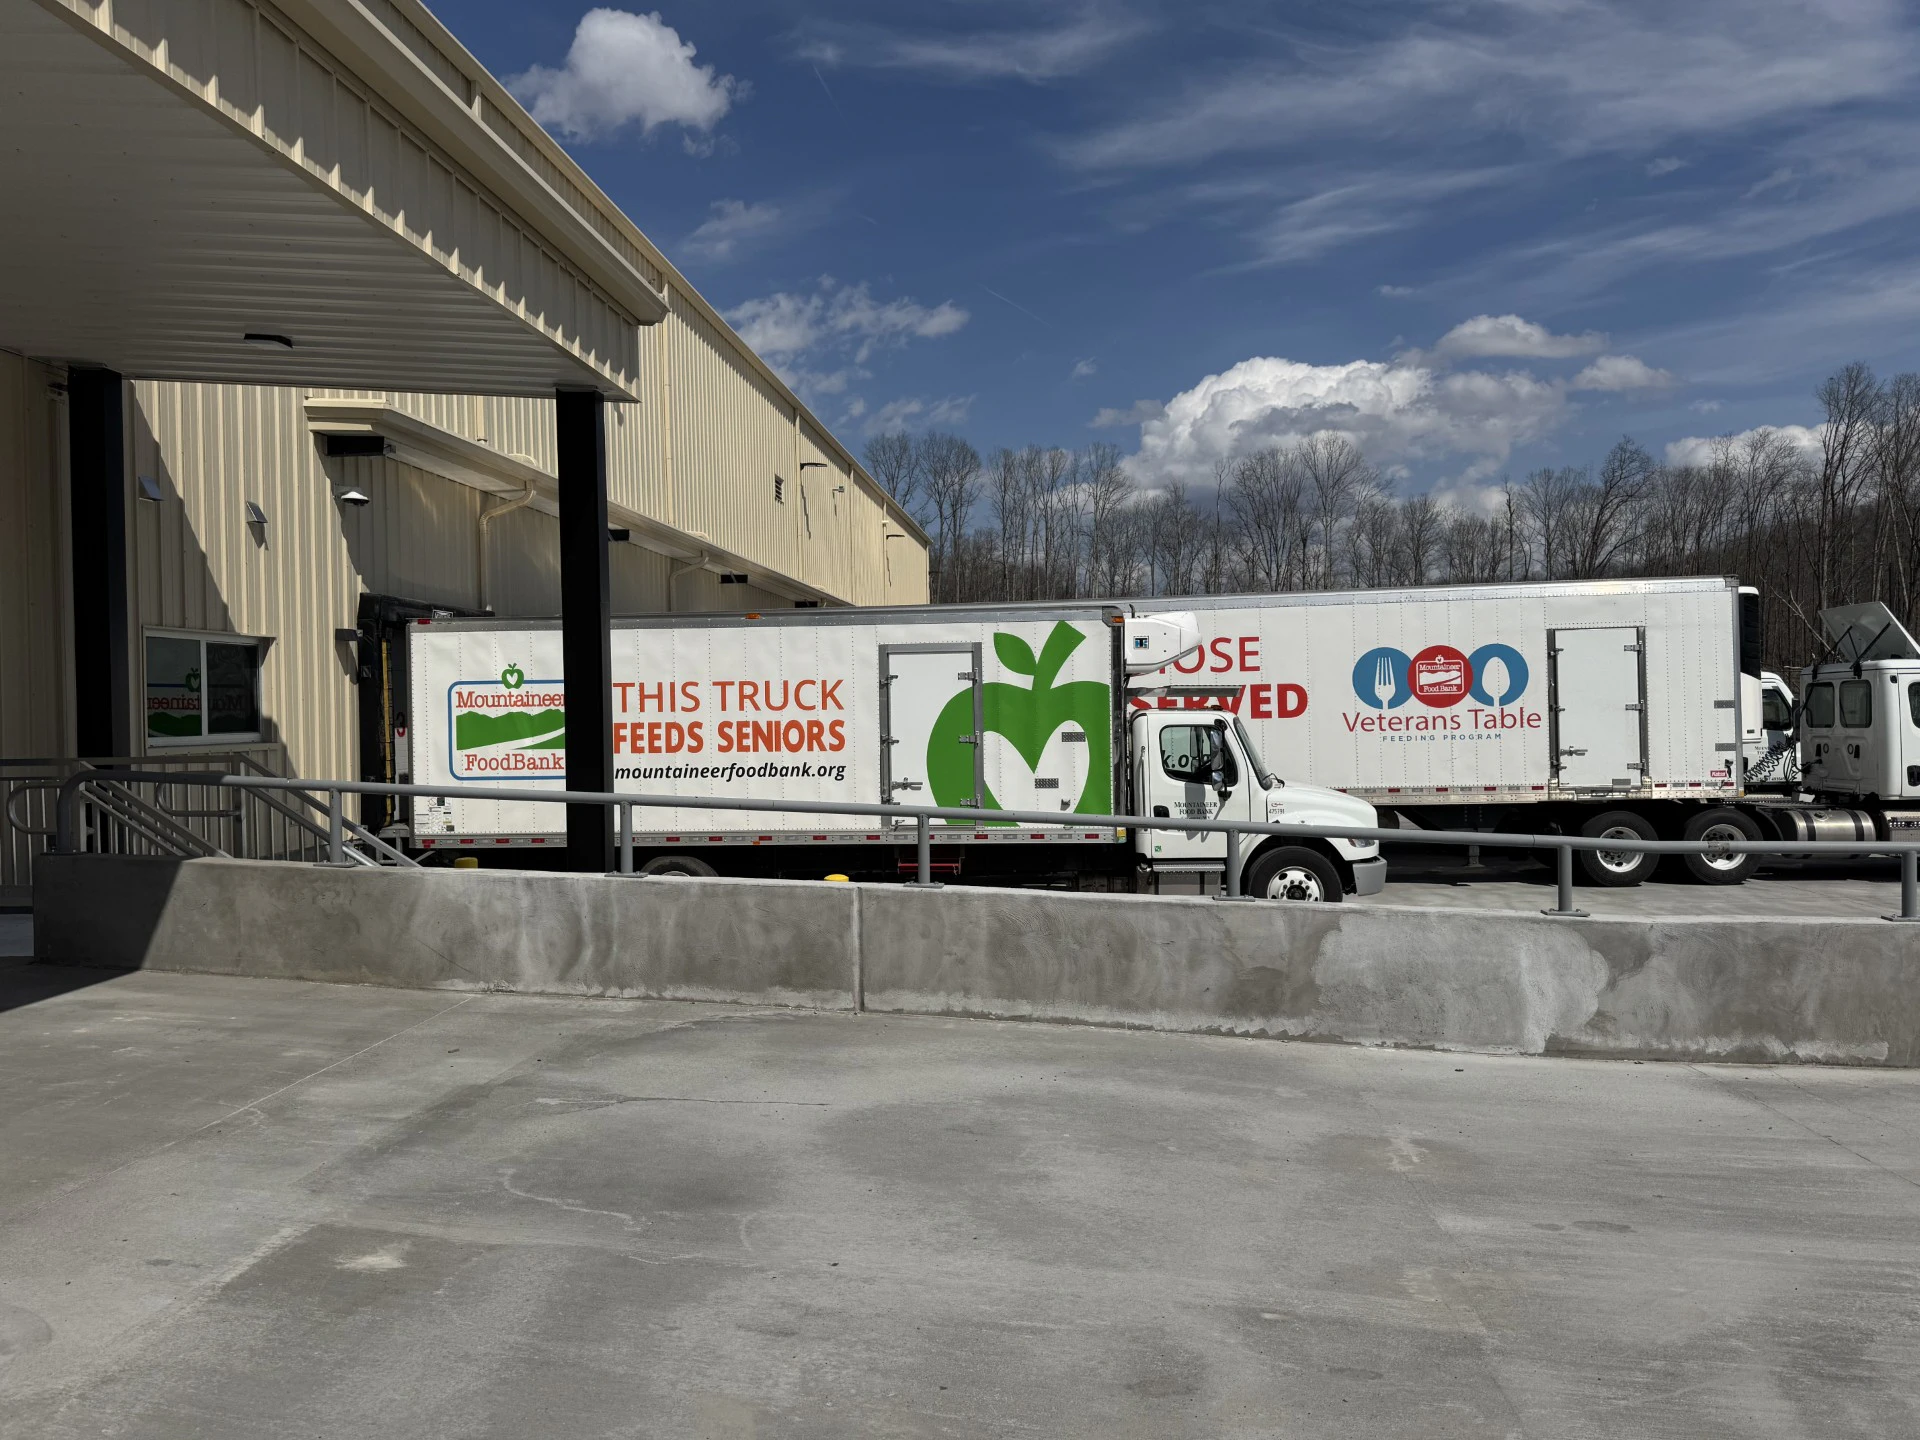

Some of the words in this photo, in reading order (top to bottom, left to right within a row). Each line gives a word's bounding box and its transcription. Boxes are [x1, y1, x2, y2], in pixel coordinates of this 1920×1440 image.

[1159, 636, 1261, 674] OSE
[612, 681, 701, 713] THIS
[712, 679, 845, 711] TRUCK
[1342, 711, 1461, 732] Veterans
[1467, 707, 1542, 730] Table
[613, 721, 704, 754] FEEDS
[717, 719, 846, 753] SENIORS
[1382, 734, 1436, 742] FEEDING
[1443, 733, 1502, 741] PROGRAM
[464, 753, 565, 771] FoodBank
[614, 762, 847, 783] mountaineerfoodbank.org
